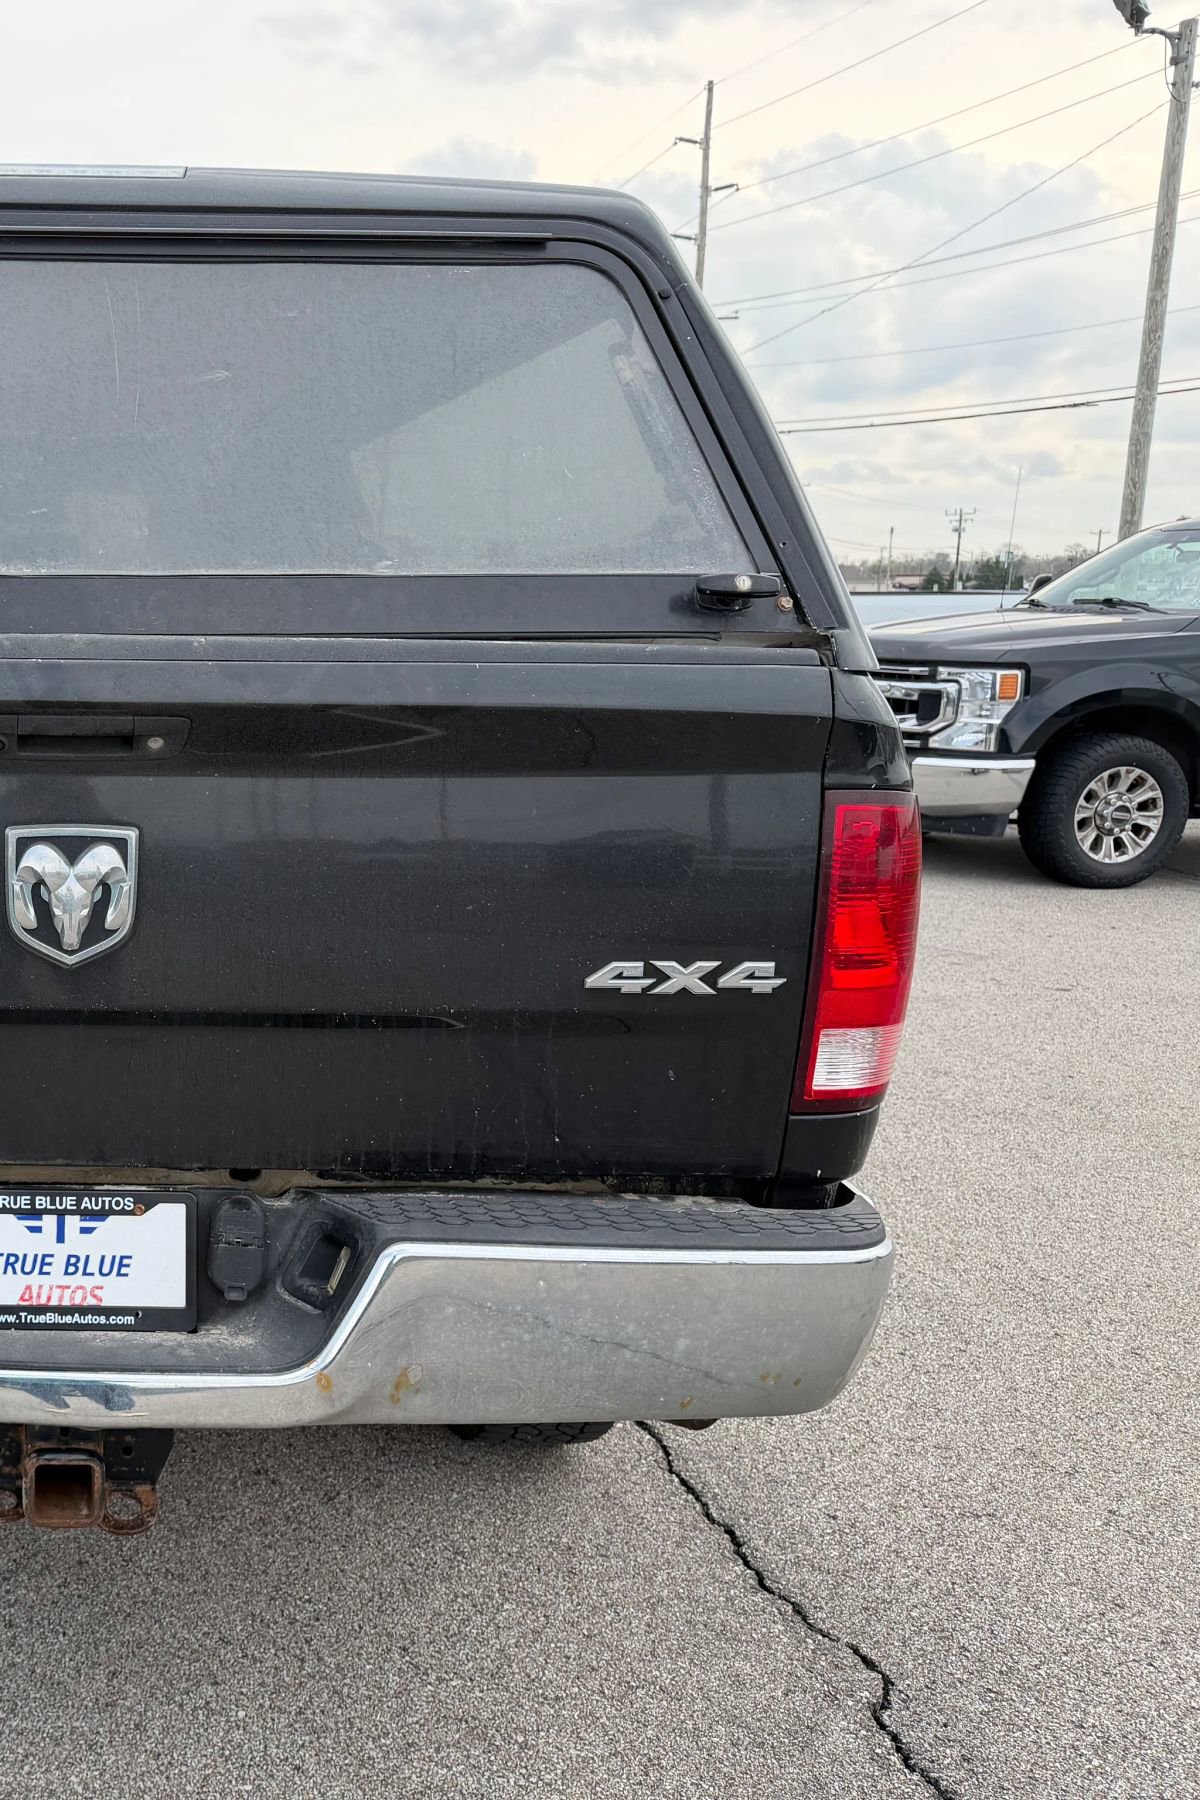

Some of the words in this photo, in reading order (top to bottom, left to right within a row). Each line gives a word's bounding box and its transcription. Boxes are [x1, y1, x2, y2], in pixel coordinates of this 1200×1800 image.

[584, 961, 787, 994] 4X4
[35, 1196, 77, 1210] BLUE
[80, 1197, 134, 1211] AUTOS
[63, 1254, 133, 1277] BLUE
[17, 1284, 104, 1306] AUTOS
